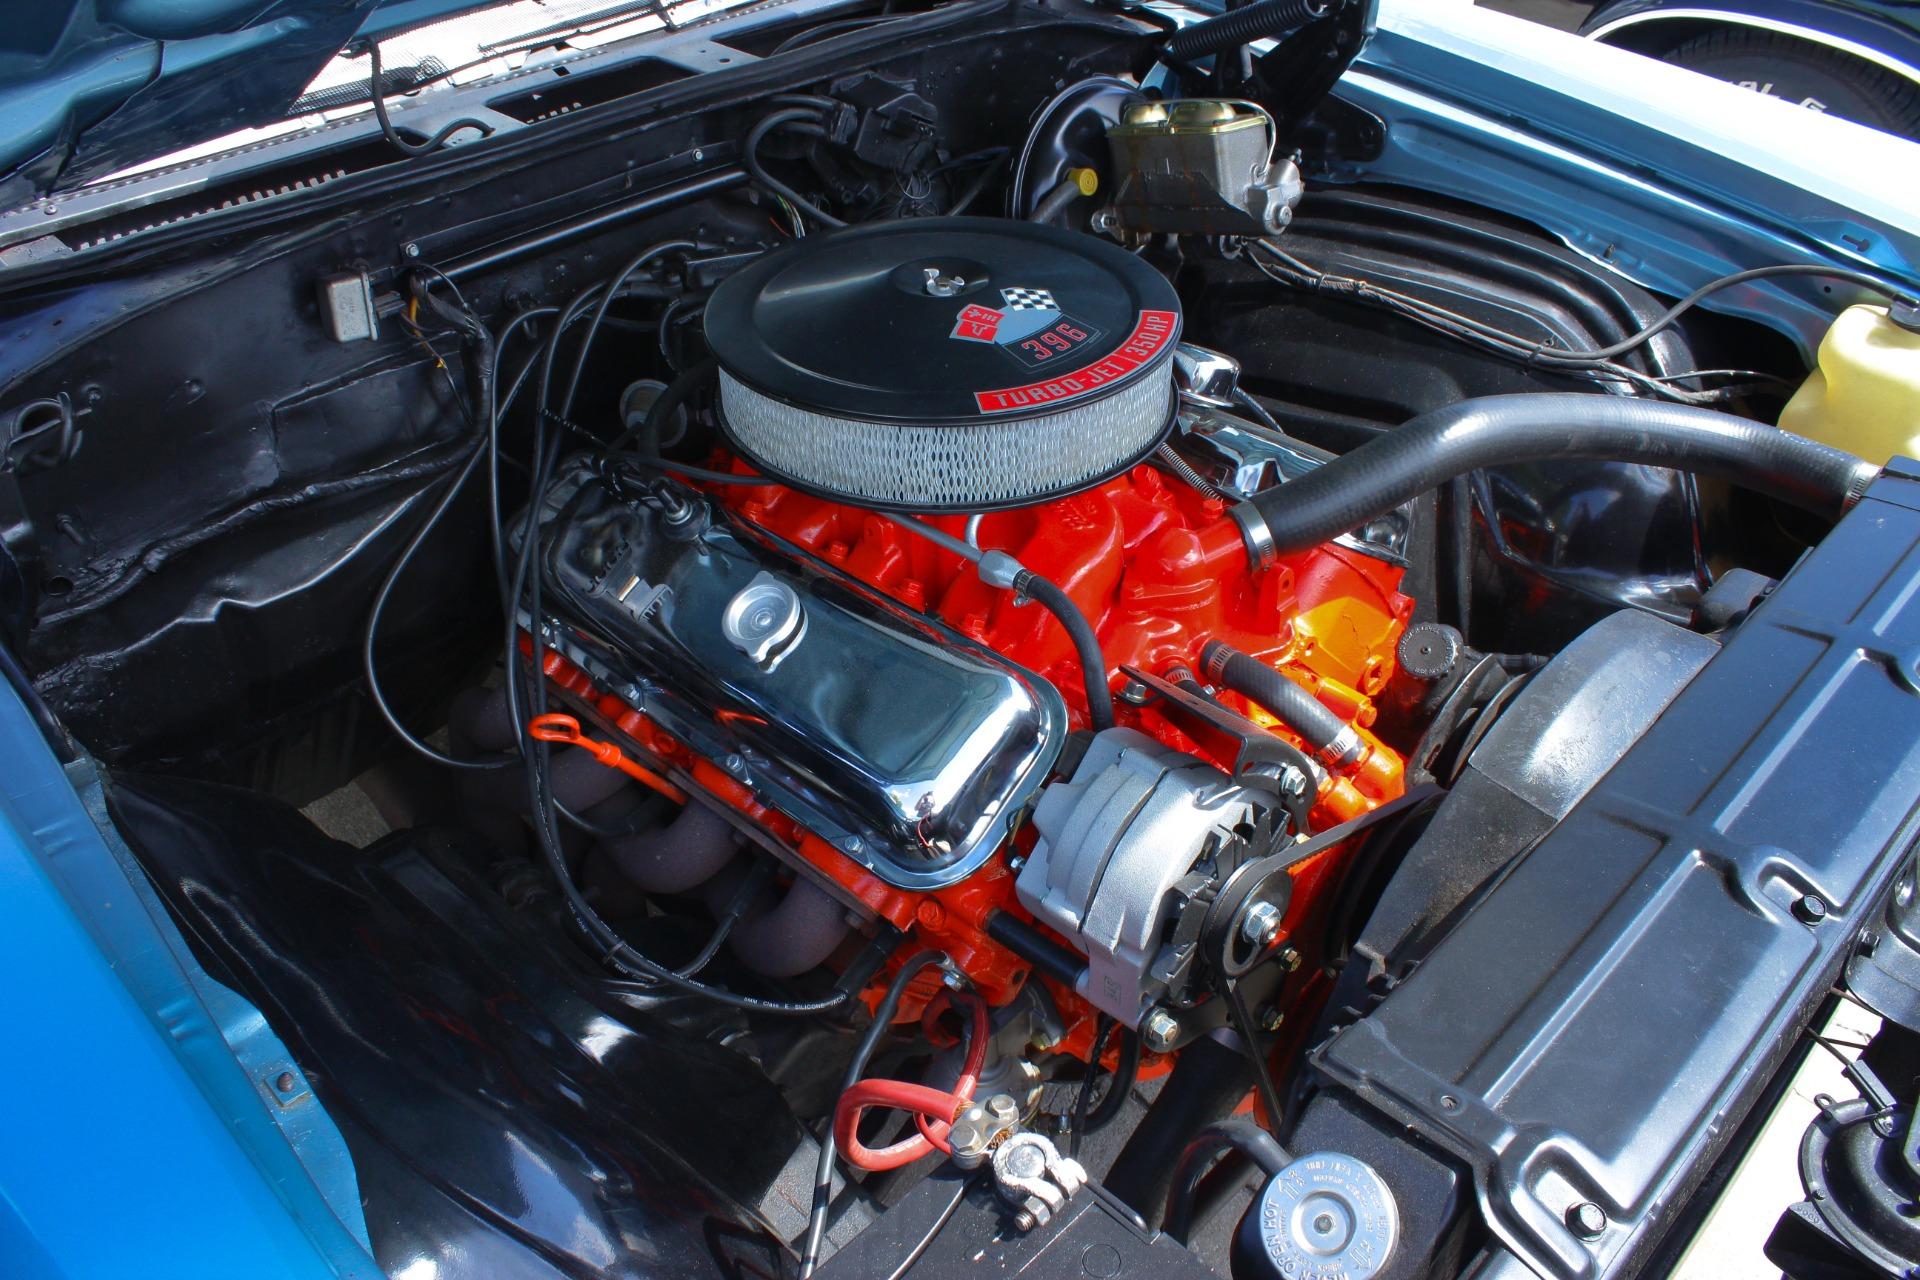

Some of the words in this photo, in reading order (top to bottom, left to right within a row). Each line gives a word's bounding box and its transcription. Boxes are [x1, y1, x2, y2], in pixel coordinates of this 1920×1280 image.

[996, 360, 1125, 407] TURBO-JET
[1124, 332, 1161, 357] 350
[1148, 315, 1169, 332] HP
[1021, 323, 1087, 361] 396
[794, 1002, 825, 1010] SILICONE
[1263, 1198, 1280, 1230] HOT
[1266, 1234, 1296, 1273] OPEN
